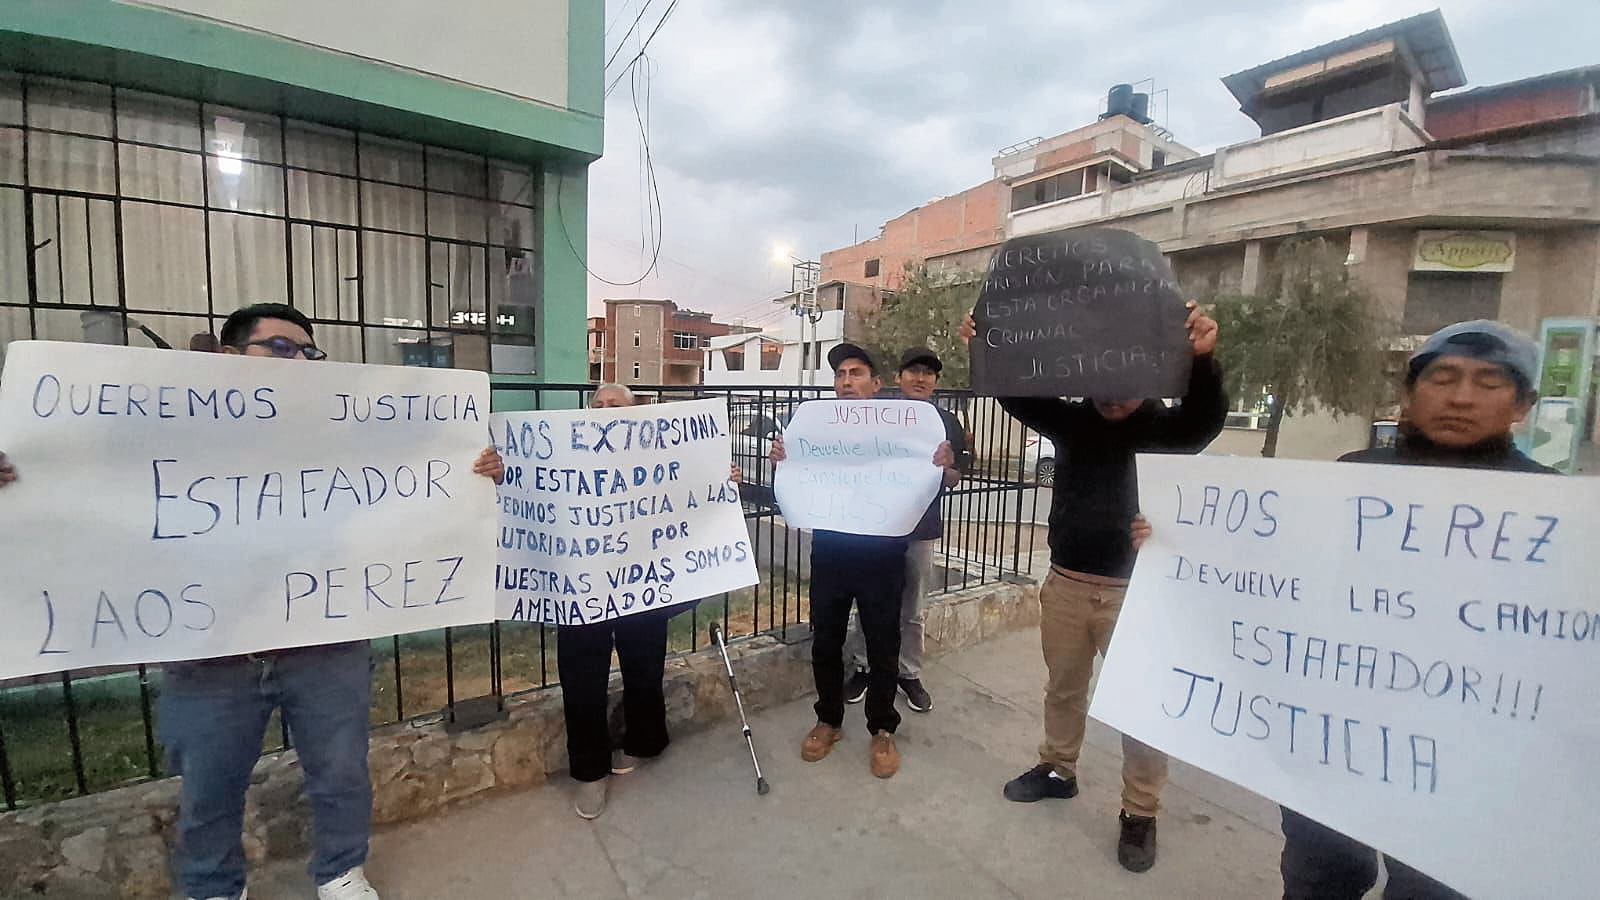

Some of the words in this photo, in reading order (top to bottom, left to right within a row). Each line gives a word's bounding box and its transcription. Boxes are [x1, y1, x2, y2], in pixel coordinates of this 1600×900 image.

[32, 374, 277, 419] QUEREMOS
[329, 393, 479, 422] JUSTICIA
[826, 405, 918, 428] JUSTICIA
[152, 458, 451, 539] ESTAFADOR
[535, 460, 681, 497] ESTAFADOR
[568, 493, 674, 527] JUSTICIA
[686, 490, 699, 510] A
[707, 480, 739, 504] LAS
[1175, 484, 1280, 539] LAOS
[1347, 495, 1560, 564] PEREZ
[496, 526, 630, 559] UTORIDADES
[651, 520, 690, 550] POR
[606, 556, 677, 590] VIDAS
[684, 541, 748, 575] SOMOS
[1170, 554, 1301, 602] DEVUELVE
[1349, 584, 1417, 620] LAS
[39, 583, 216, 656] LAOS
[284, 556, 465, 622] PEREZ
[511, 583, 674, 625] AMENASADOS
[1231, 620, 1545, 722] ESTAFADOR!!!
[1161, 666, 1440, 794] JUSTICIA
